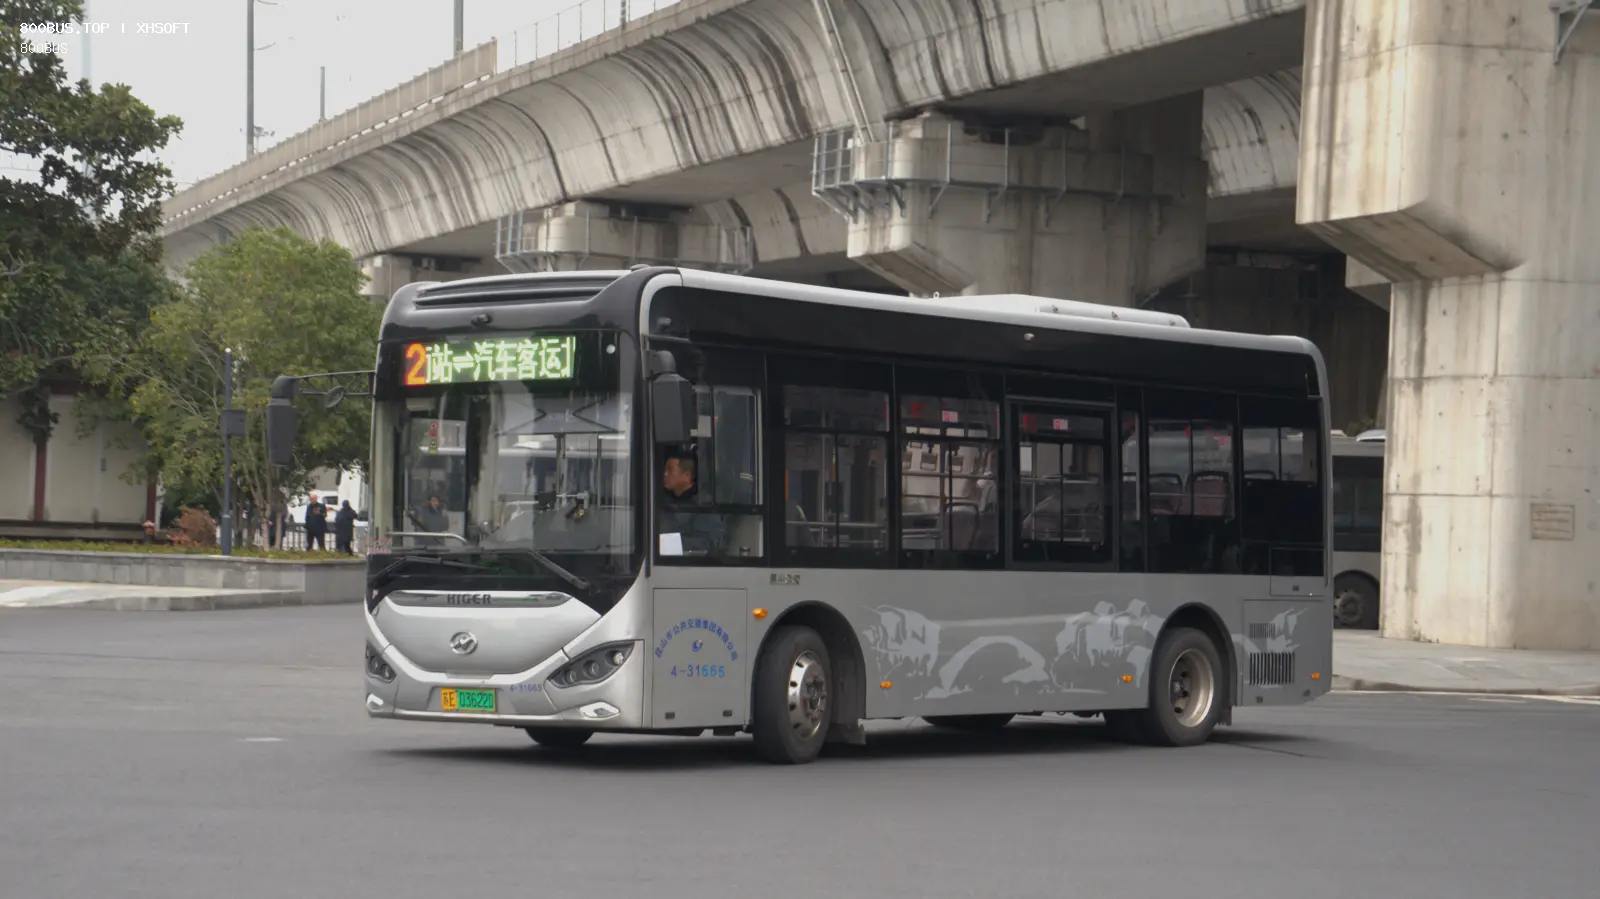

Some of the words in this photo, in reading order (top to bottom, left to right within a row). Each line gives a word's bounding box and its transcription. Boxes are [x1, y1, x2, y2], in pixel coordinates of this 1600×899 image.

[405, 342, 427, 386] 2
[447, 593, 491, 605] HIGER
[670, 664, 726, 678] 4-31665
